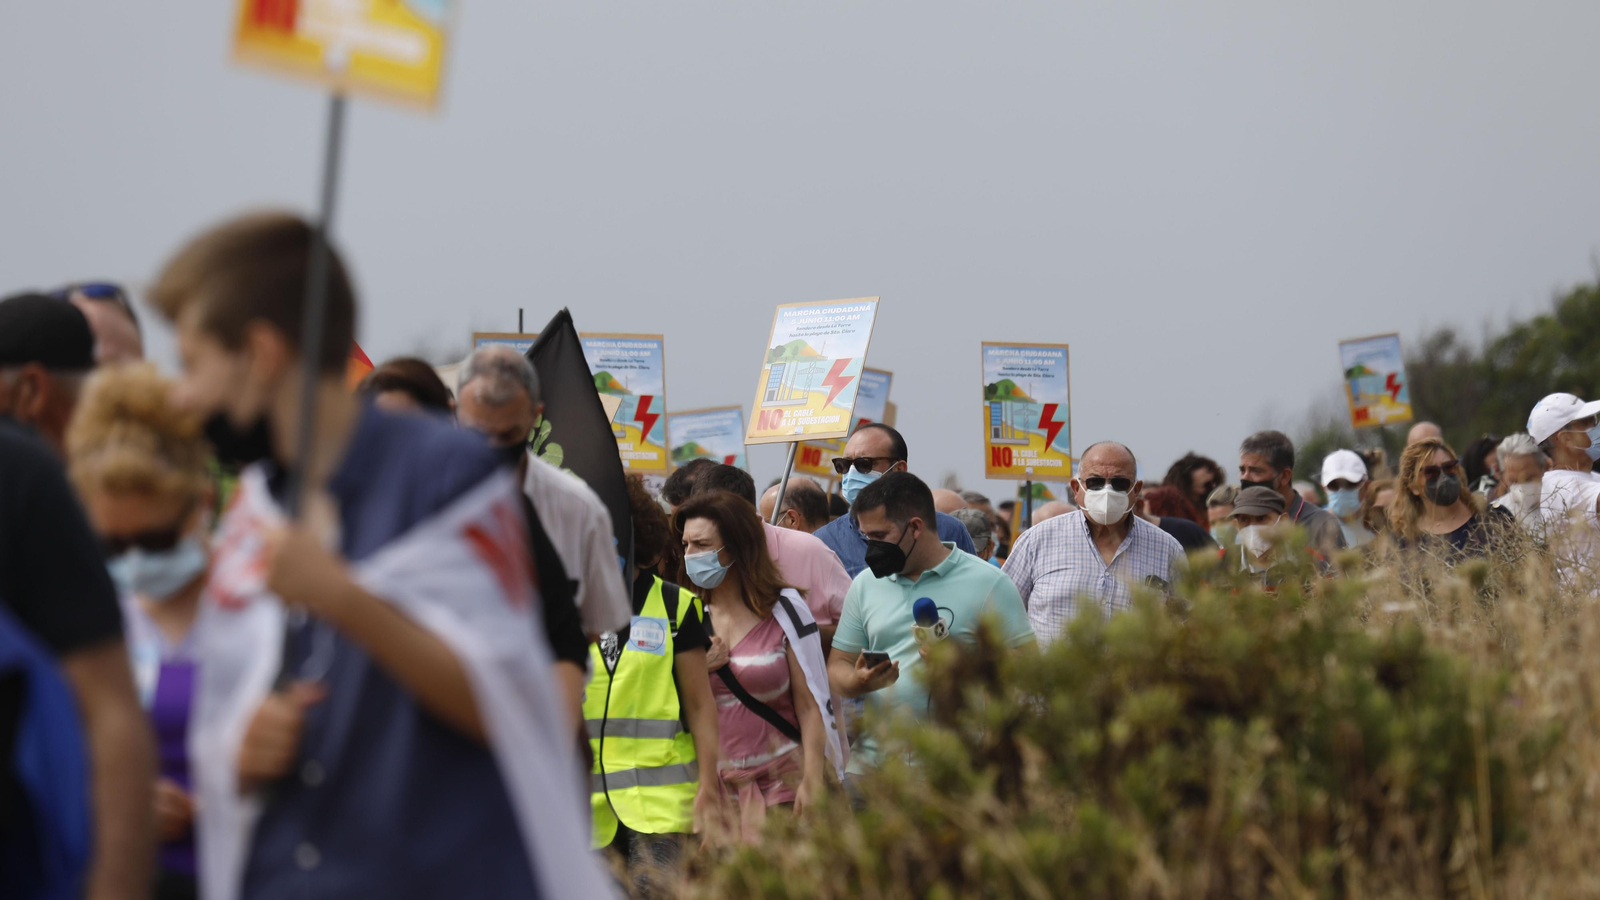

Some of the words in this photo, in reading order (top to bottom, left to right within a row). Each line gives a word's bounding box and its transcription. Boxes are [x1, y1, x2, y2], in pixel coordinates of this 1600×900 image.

[784, 308, 820, 318] MARCHA
[822, 305, 871, 314] CIUDADANA
[757, 409, 783, 430] NO
[794, 408, 814, 417] CABLE
[787, 418, 796, 426] LA
[798, 415, 840, 425] SUBESTACION
[622, 452, 658, 460] SUBESTACION
[801, 446, 822, 467] NO
[992, 446, 1012, 468] NO
[1026, 459, 1063, 467] SUBESTACION
